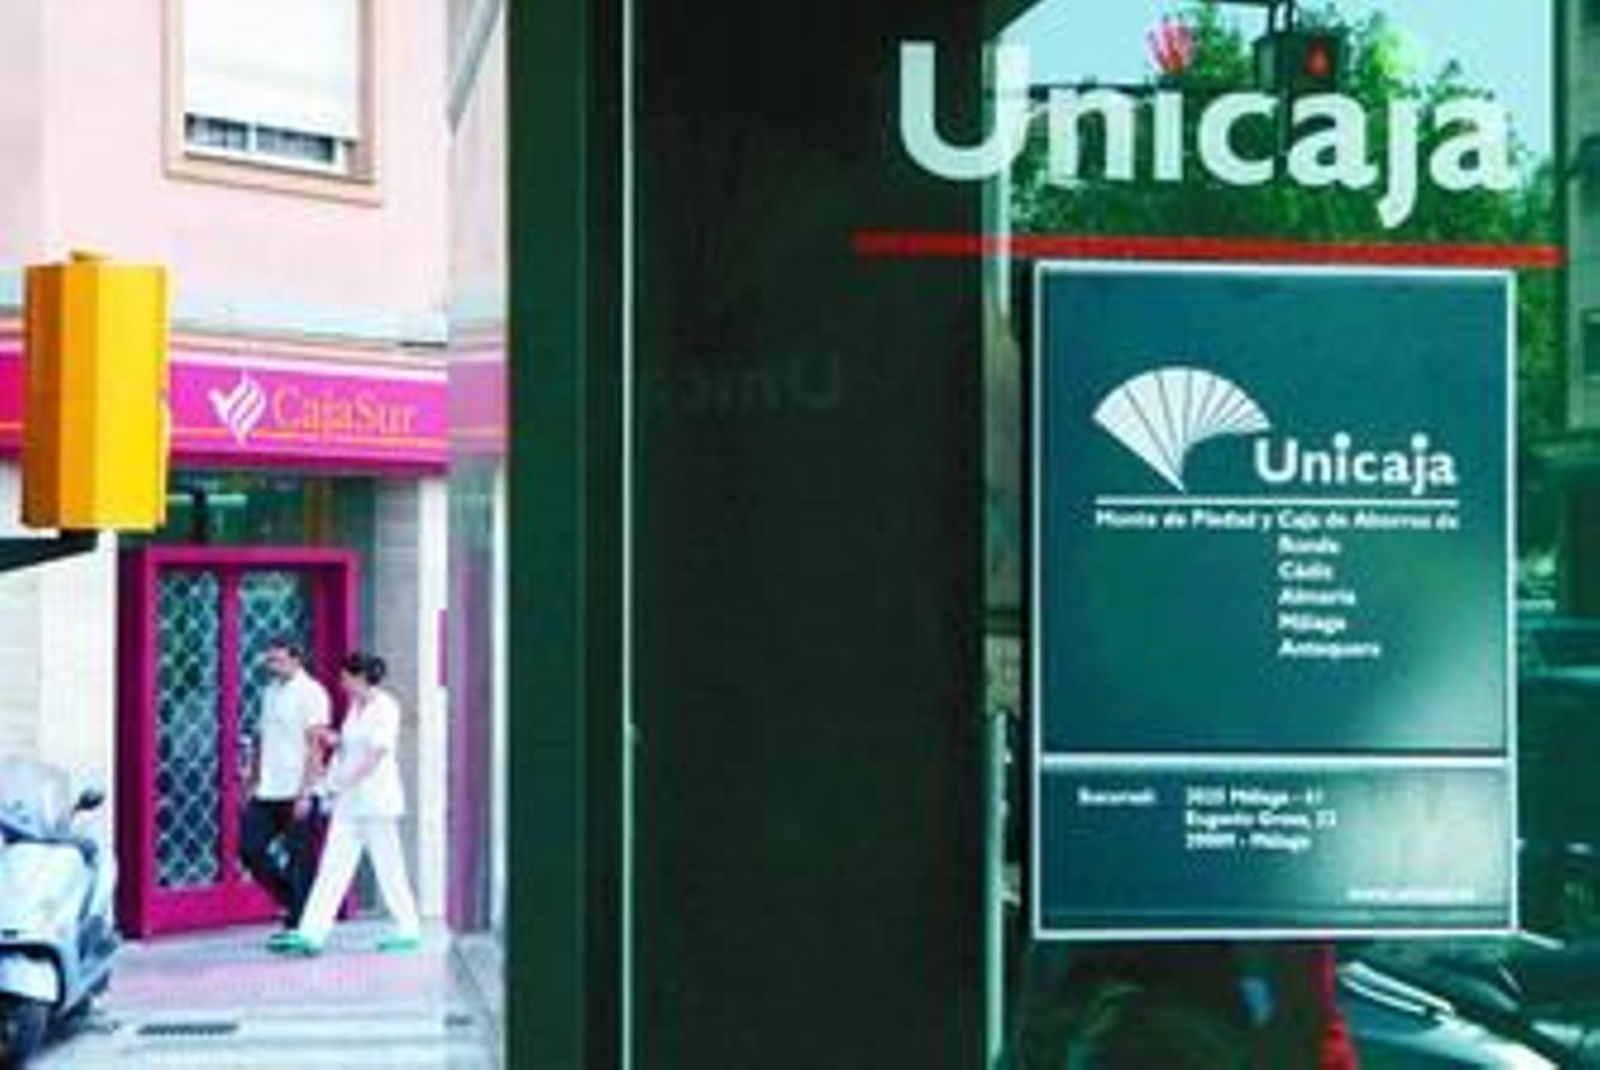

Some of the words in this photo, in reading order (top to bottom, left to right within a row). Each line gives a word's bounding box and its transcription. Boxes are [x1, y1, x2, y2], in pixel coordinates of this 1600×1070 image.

[899, 34, 1517, 228] Unicaja
[273, 383, 418, 440] CajaSur
[1254, 432, 1458, 497] Unicaja
[1096, 509, 1155, 530] Monte
[1162, 509, 1184, 530] de
[1191, 508, 1256, 530] Piedad
[1277, 508, 1322, 533] Caja
[1325, 509, 1348, 530] de
[1352, 508, 1432, 530] Ahorros
[1435, 511, 1458, 530] de
[1278, 534, 1341, 554] Ronda
[1277, 637, 1382, 659] Antequera
